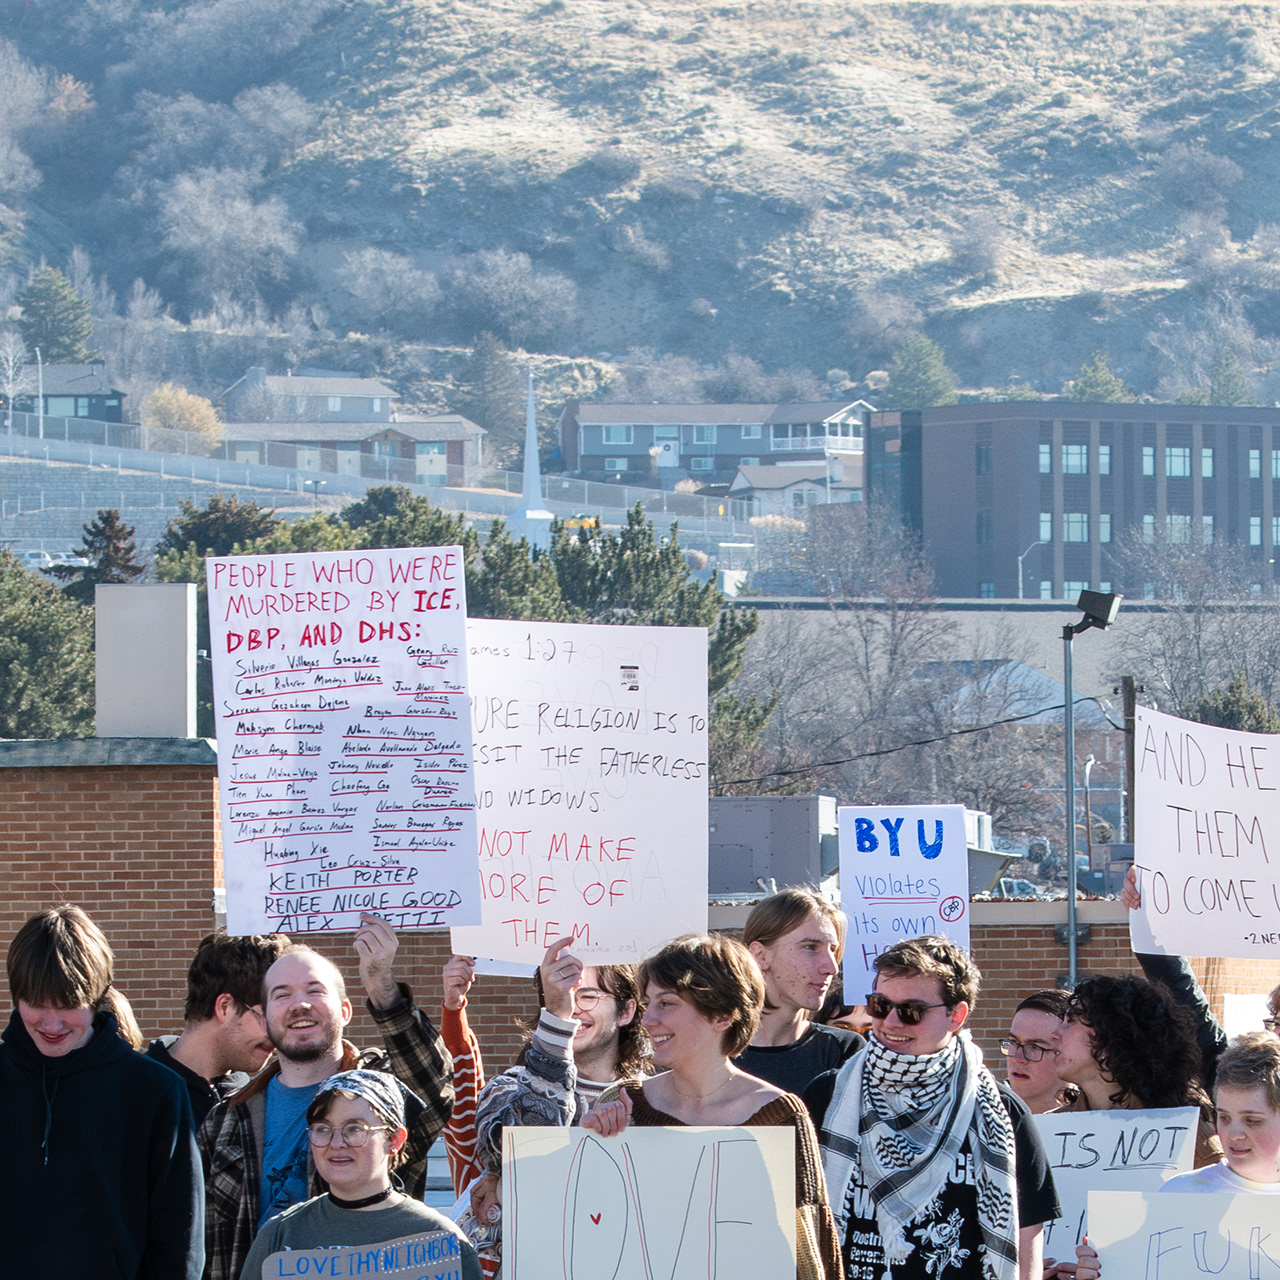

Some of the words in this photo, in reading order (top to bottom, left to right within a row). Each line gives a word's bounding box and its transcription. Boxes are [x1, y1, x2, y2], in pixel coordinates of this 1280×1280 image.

[214, 560, 297, 589] PEOPLE
[312, 557, 373, 585] WHO
[389, 553, 457, 583] WERE
[225, 591, 350, 622] MURDERED
[366, 590, 400, 612] BY
[413, 587, 461, 612] ICE,
[227, 627, 285, 654] DBP,
[300, 622, 343, 647] AND
[359, 620, 421, 644] DHS:
[525, 633, 577, 663] 1:27
[653, 712, 677, 734] IS
[689, 714, 705, 733] TO
[541, 747, 584, 767] THE
[600, 747, 707, 780] FATHERLESS
[1226, 742, 1277, 791] HE
[478, 827, 532, 857] NOT
[548, 832, 636, 862] MAKE
[854, 817, 943, 860] BYU
[1166, 804, 1269, 864] THEM
[270, 873, 329, 890] KEITH
[354, 867, 418, 885] PORTER
[583, 879, 628, 906] OF
[1135, 864, 1170, 915] TO
[1183, 875, 1262, 919] COME
[265, 896, 321, 914] RENEE
[333, 892, 389, 911] NICOLE
[402, 890, 462, 907] GOOD
[942, 900, 960, 917] CBP
[276, 915, 333, 933] ALEX
[502, 918, 599, 949] THEM.
[853, 912, 879, 935] its
[892, 915, 936, 935] own
[1051, 1132, 1101, 1169] IS
[1110, 1126, 1191, 1166] NOT
[279, 1256, 341, 1277] LOVE
[347, 1250, 382, 1276] THY
[384, 1233, 459, 1270] NEIGHBOR
